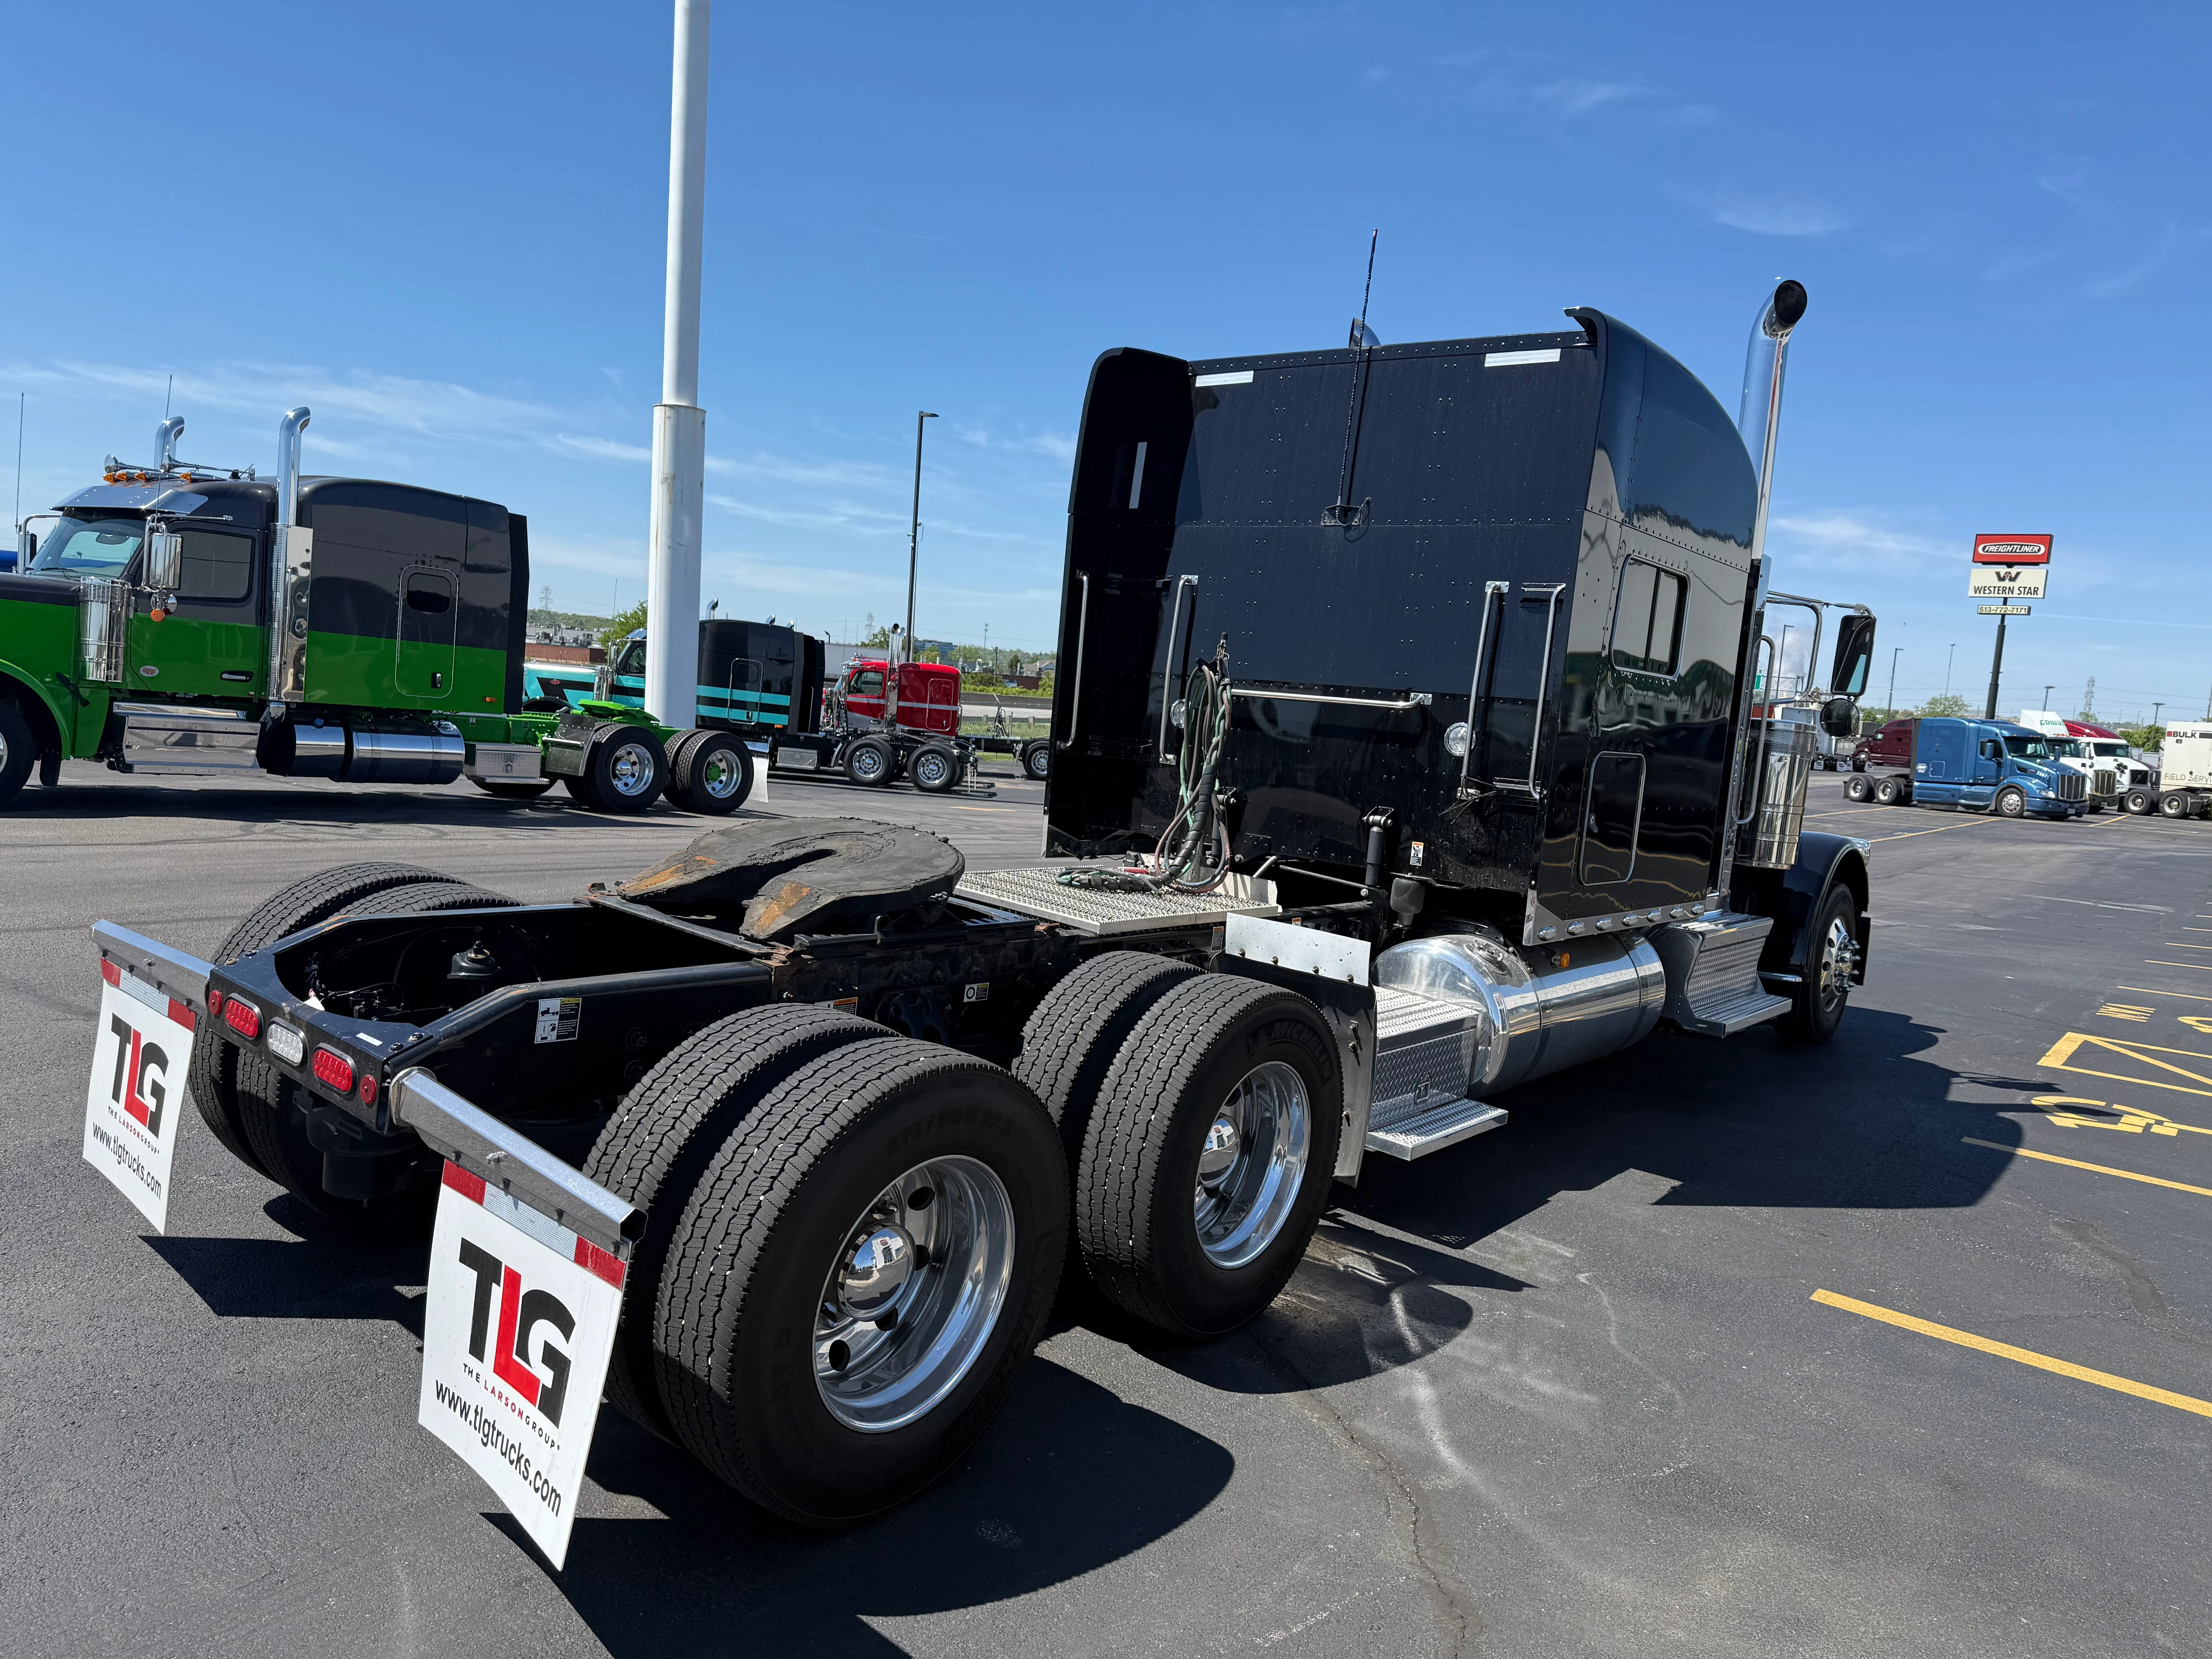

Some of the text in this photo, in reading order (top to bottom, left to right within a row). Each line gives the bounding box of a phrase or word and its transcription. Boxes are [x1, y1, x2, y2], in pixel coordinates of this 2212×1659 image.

[1974, 586, 2039, 596] WESTERN STAR
[111, 1012, 169, 1139] TLG
[1270, 1021, 1332, 1079] MICHELIN
[108, 1106, 117, 1120] THE
[119, 1115, 140, 1139] LARSON
[93, 1122, 161, 1200] www.tlgtrucks.com
[459, 1237, 576, 1429] TLG
[463, 1362, 481, 1384] THE
[484, 1379, 524, 1420] LARSON
[436, 1379, 562, 1518] www.tlgtrucks.com
